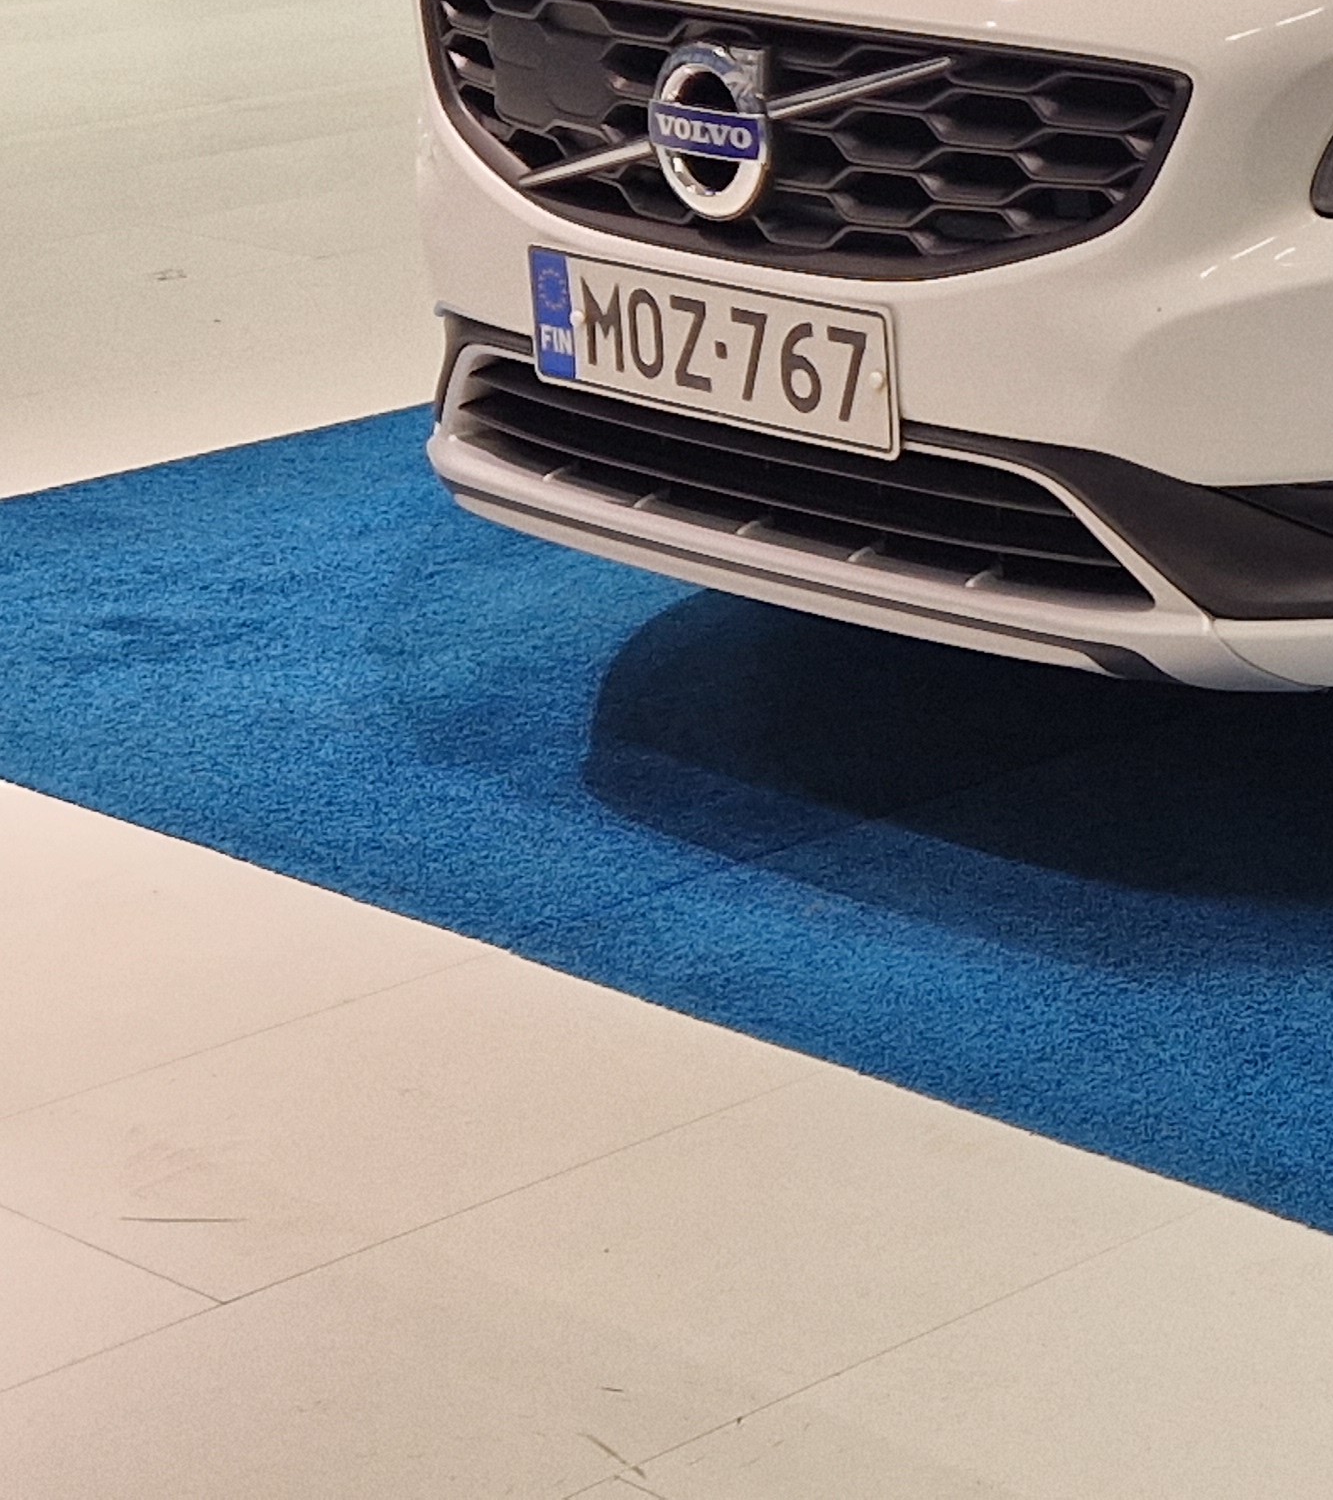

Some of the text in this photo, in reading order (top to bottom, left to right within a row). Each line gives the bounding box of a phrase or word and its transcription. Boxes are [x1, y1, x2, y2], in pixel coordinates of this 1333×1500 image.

[654, 111, 753, 149] VOLVO
[540, 324, 573, 356] FIN
[580, 276, 868, 422] MOZ-767
